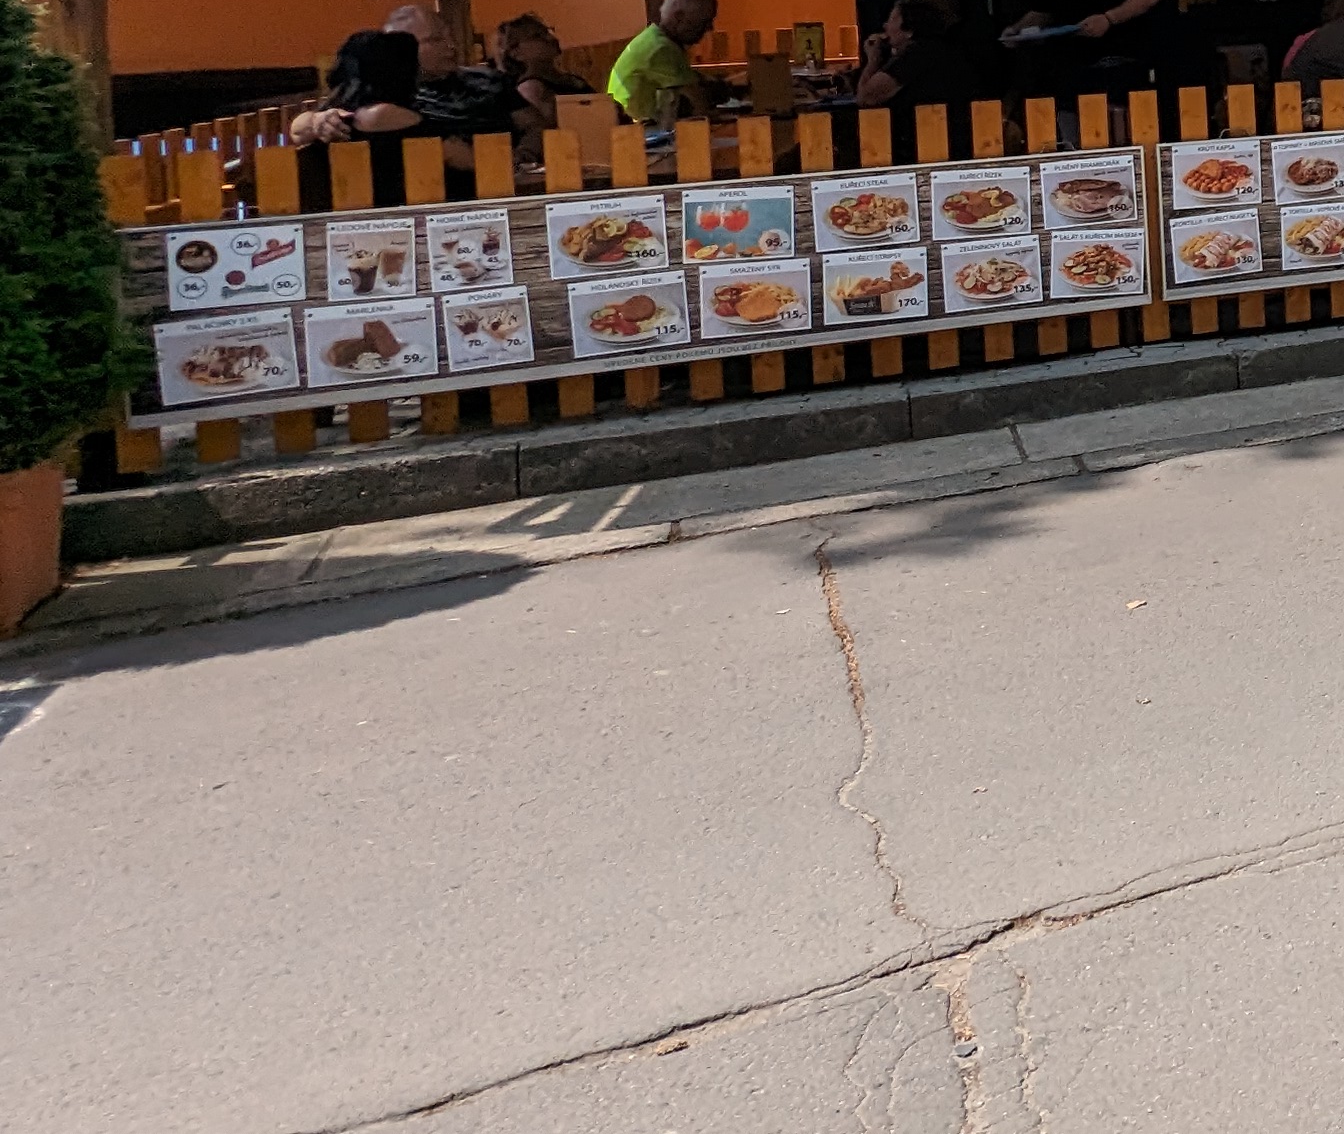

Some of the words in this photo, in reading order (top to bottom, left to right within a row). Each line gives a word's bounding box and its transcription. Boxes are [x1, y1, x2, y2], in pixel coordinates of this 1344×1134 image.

[1235, 185, 1259, 195] 120,-
[765, 237, 788, 248] 95,-
[1115, 275, 1140, 285] 150,-
[1013, 284, 1039, 294] 135,-
[897, 296, 924, 308] 170,-
[778, 309, 808, 320] 115,-
[403, 353, 428, 364] 59,-
